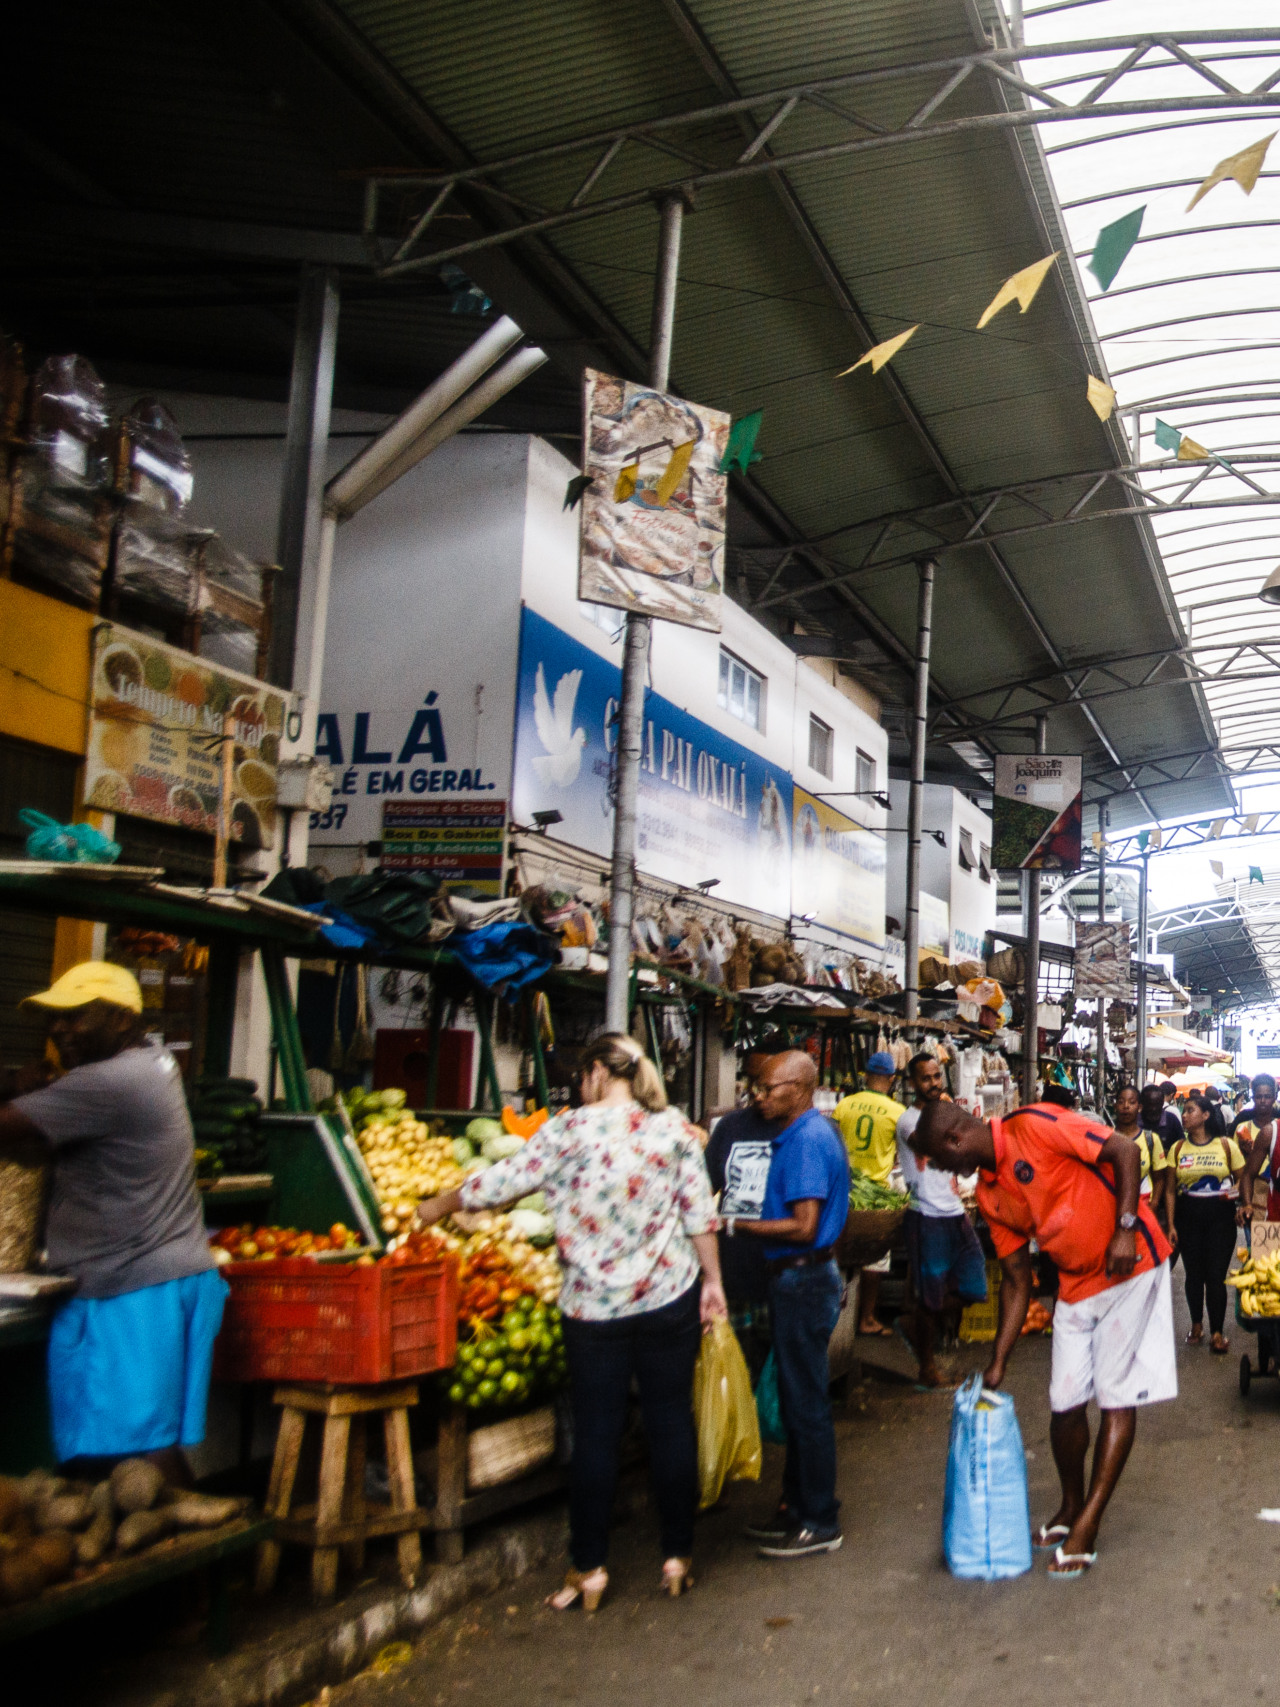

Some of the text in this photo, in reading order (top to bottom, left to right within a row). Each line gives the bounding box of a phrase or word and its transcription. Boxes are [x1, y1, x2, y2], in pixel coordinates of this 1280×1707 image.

[118, 673, 198, 726] Tempero
[203, 702, 264, 749] Naural
[1025, 757, 1046, 769] São
[660, 727, 693, 793] PAI
[697, 750, 748, 820] OXALÁ
[1015, 764, 1061, 780] Joaquim
[366, 771, 404, 795] EM
[409, 767, 496, 794] GERAL.
[384, 828, 500, 839] Box Do Gabriel
[384, 843, 499, 853] Box Do Anderson
[383, 856, 409, 865] Box
[411, 855, 431, 866] Do
[850, 1102, 888, 1116] FRED
[855, 1114, 874, 1152] 9
